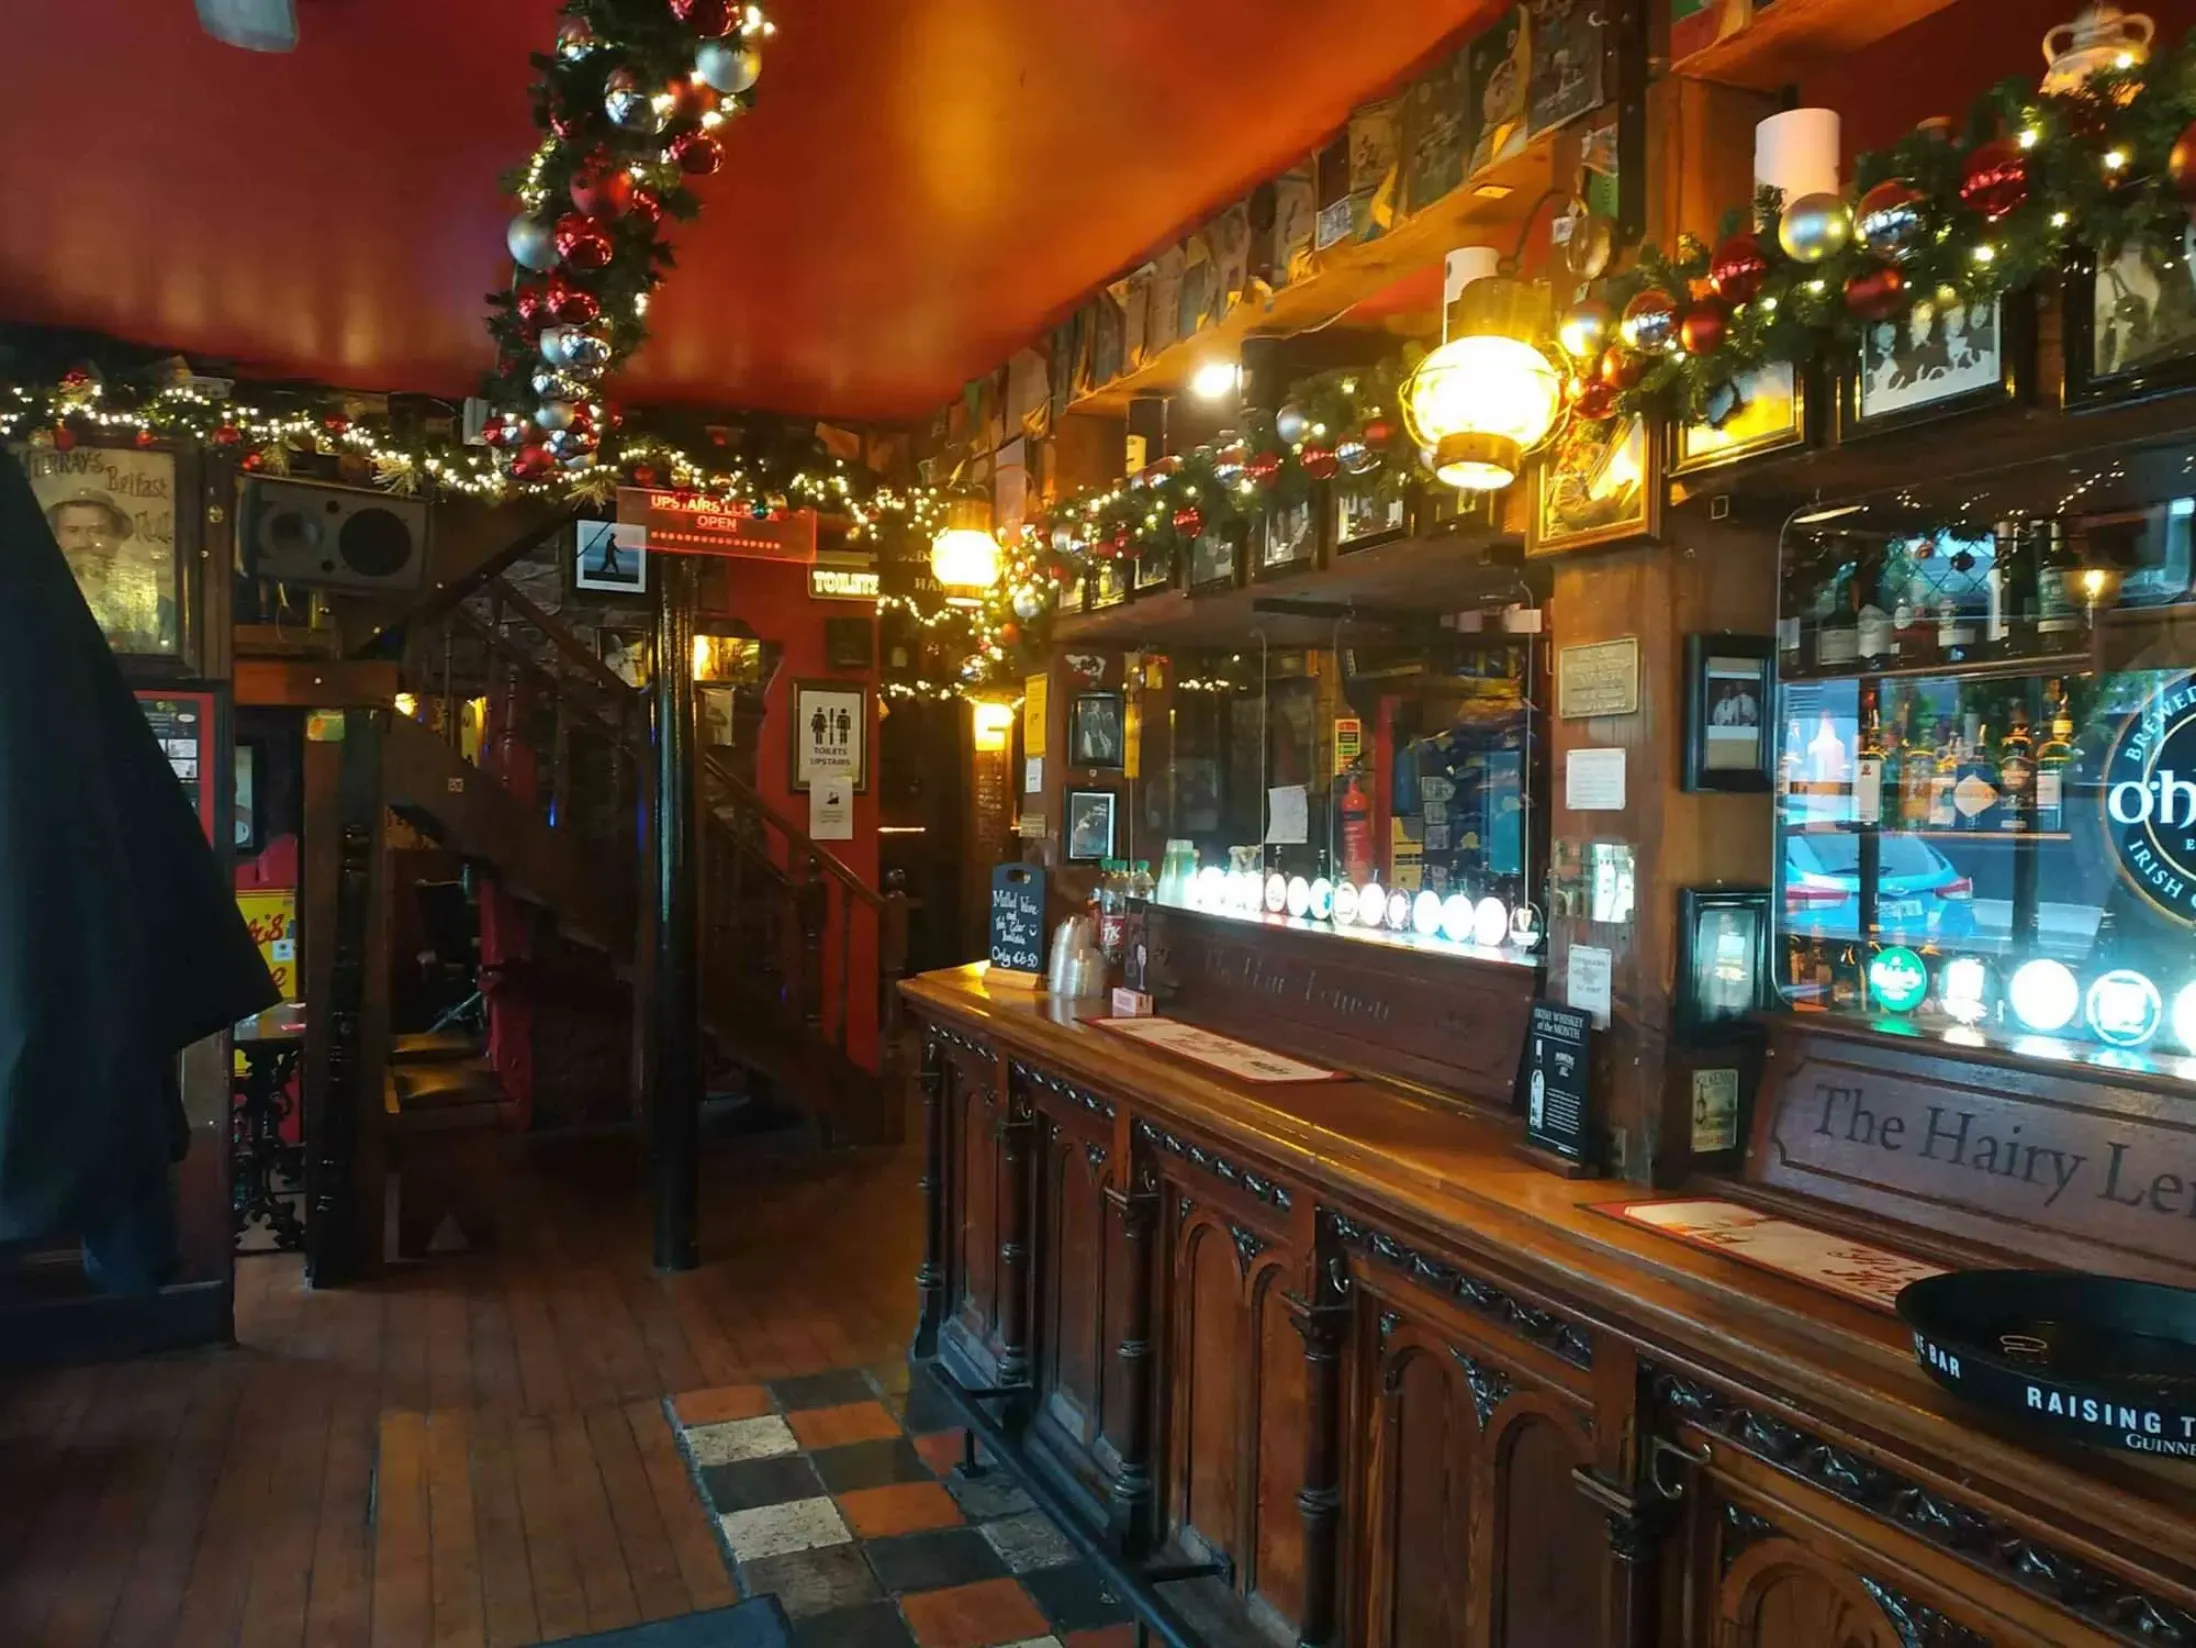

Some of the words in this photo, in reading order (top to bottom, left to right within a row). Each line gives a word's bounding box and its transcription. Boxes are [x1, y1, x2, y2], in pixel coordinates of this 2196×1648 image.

[696, 514, 737, 530] OPEN
[813, 571, 879, 595] TOILETS
[810, 757, 851, 766] UPSTAIRS
[814, 747, 848, 755] TOILETS
[2128, 840, 2185, 898] IRISH
[991, 945, 1011, 968] Only
[1814, 1083, 1906, 1152] The
[1917, 1105, 2089, 1208] Hairy
[2096, 1140, 2196, 1220] Le
[1928, 1342, 1961, 1379] BAR
[2027, 1386, 2162, 1434] RAISING
